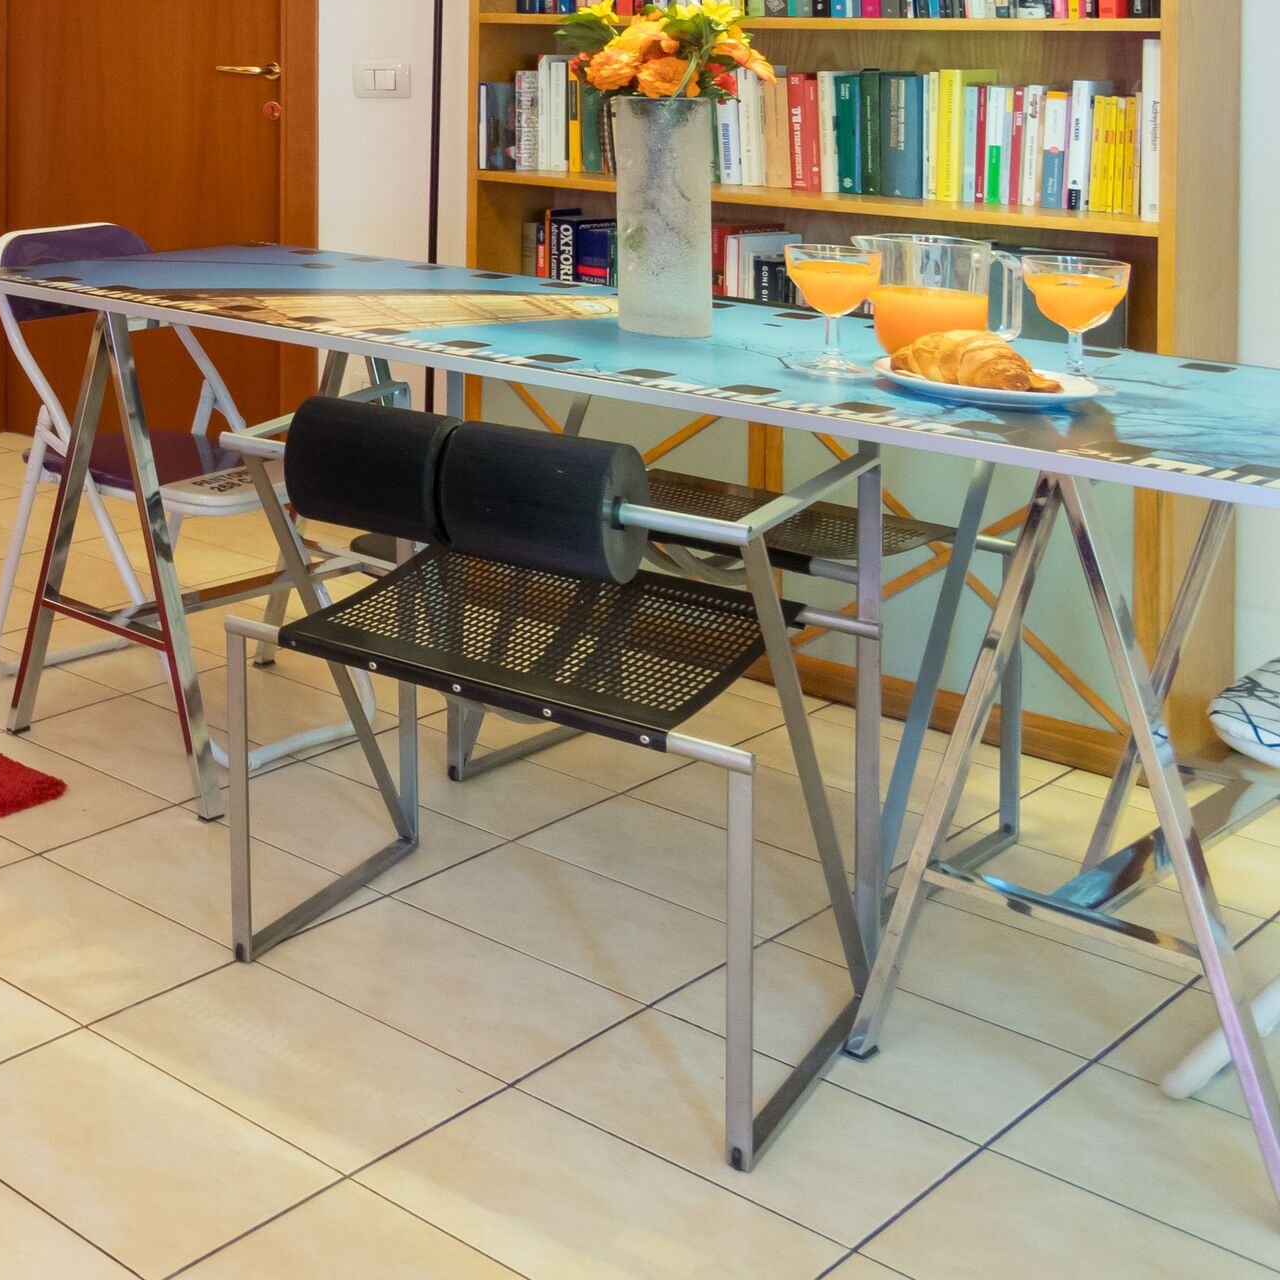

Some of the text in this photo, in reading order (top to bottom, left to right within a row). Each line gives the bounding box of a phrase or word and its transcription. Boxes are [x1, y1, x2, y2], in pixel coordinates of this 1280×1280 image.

[721, 122, 732, 170] neuromante
[551, 222, 559, 254] Advanced
[761, 265, 769, 286] GONE
[192, 470, 250, 488] PANTON
